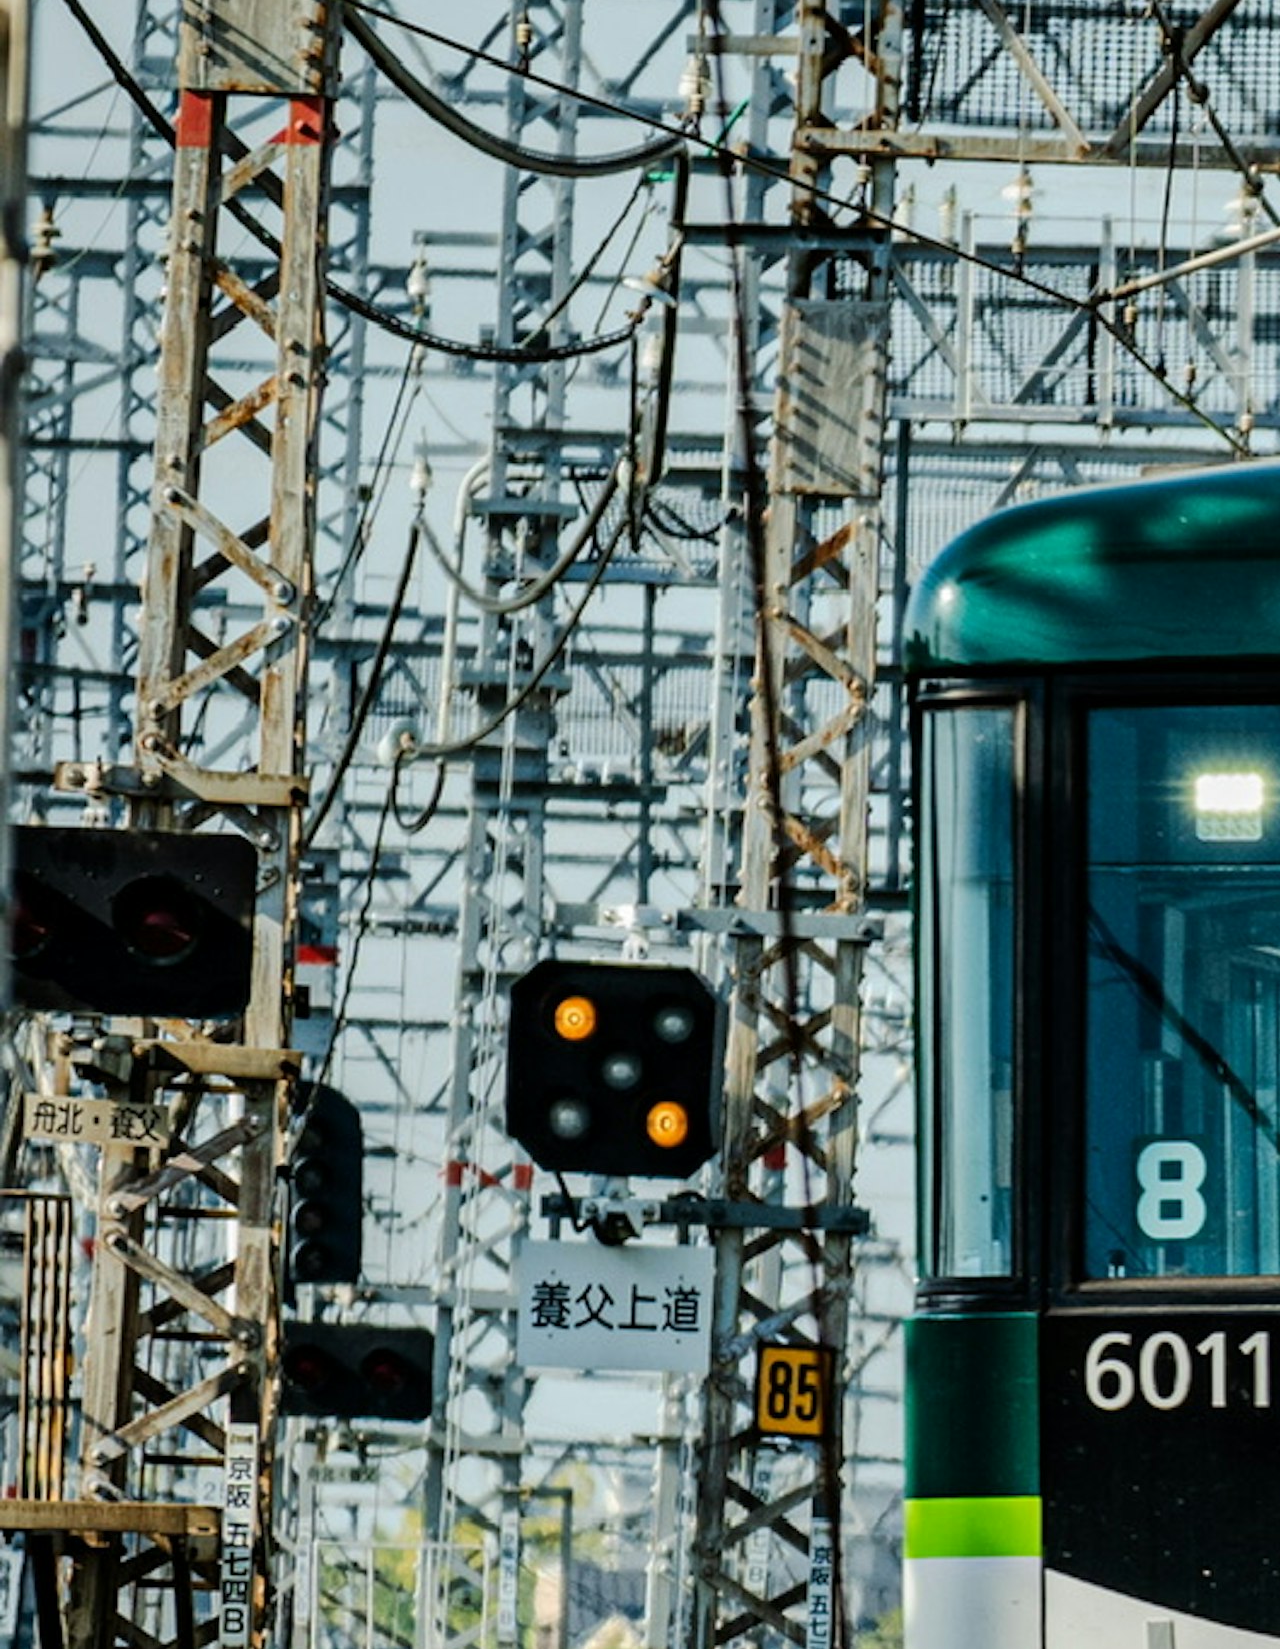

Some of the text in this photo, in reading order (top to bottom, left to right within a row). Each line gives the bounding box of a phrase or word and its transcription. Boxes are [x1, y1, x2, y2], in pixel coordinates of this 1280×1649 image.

[1136, 1140, 1207, 1239] 8
[531, 1280, 701, 1333] 養父上道
[767, 1360, 818, 1421] 85
[1084, 1330, 1271, 1411] 6011
[226, 1456, 253, 1509] 京阪
[810, 1547, 831, 1584] 京阪
